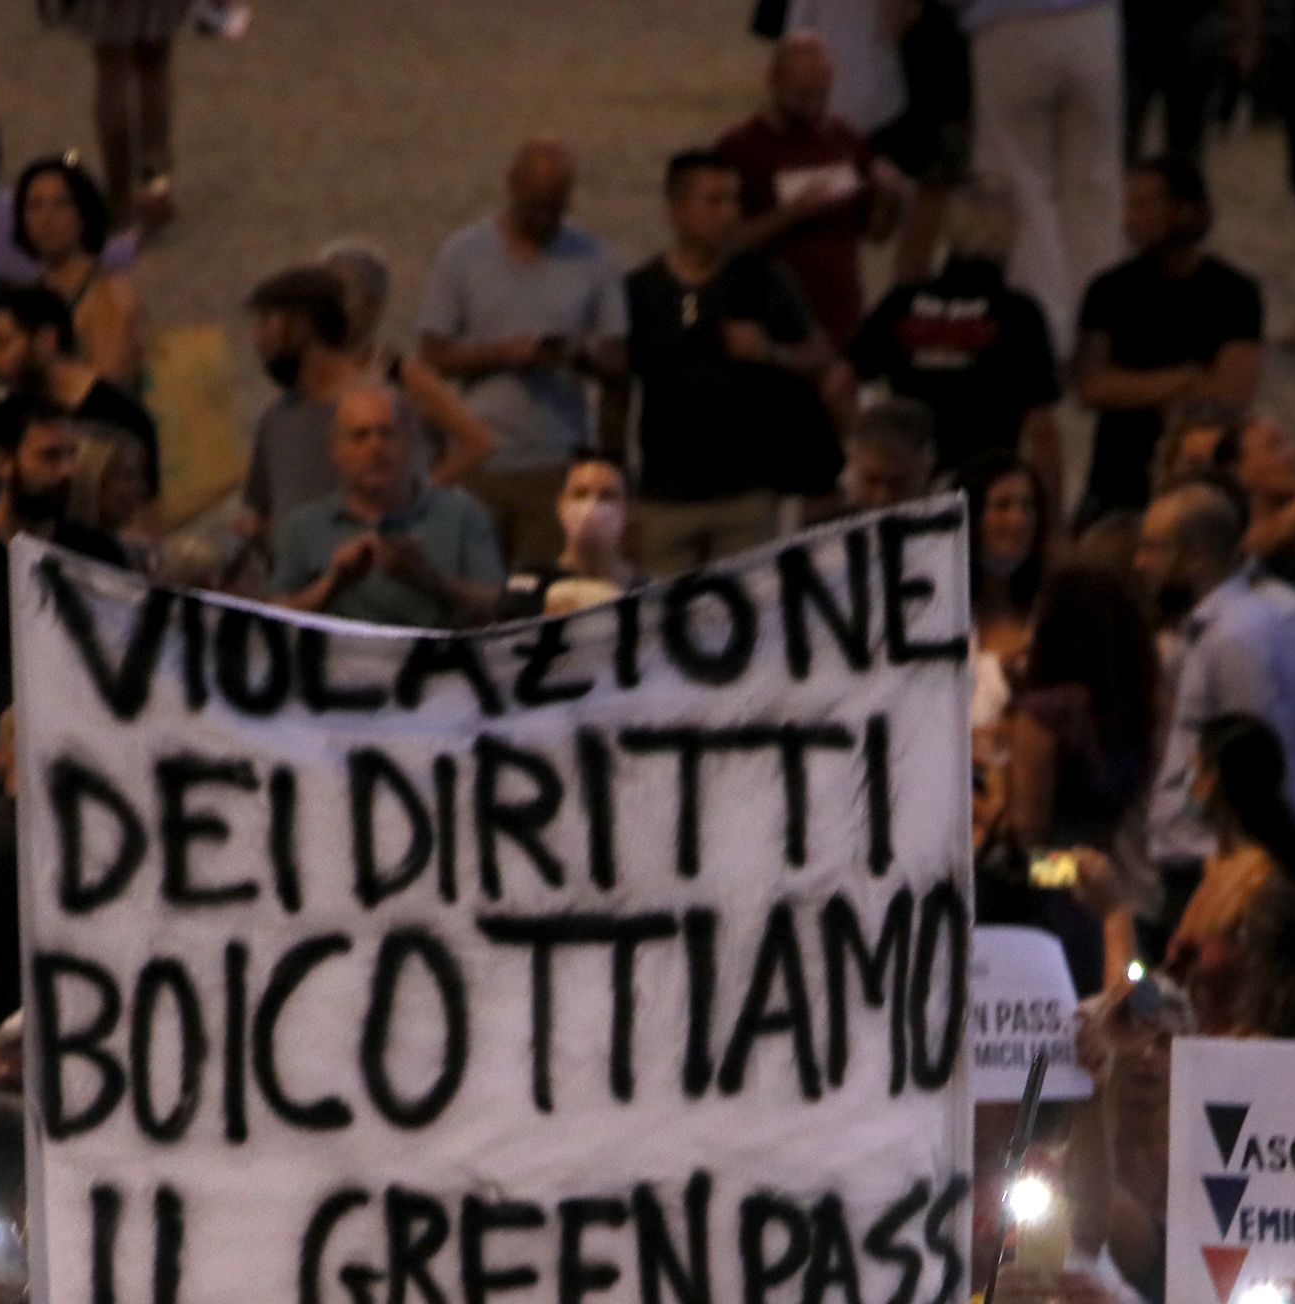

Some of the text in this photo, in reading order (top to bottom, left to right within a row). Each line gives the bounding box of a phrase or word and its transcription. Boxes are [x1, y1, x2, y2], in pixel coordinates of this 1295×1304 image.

[36, 515, 967, 719] VIOLAZIONE
[48, 714, 894, 916] DEI DIRITTI
[33, 878, 968, 1145] BOICOTTIAMO
